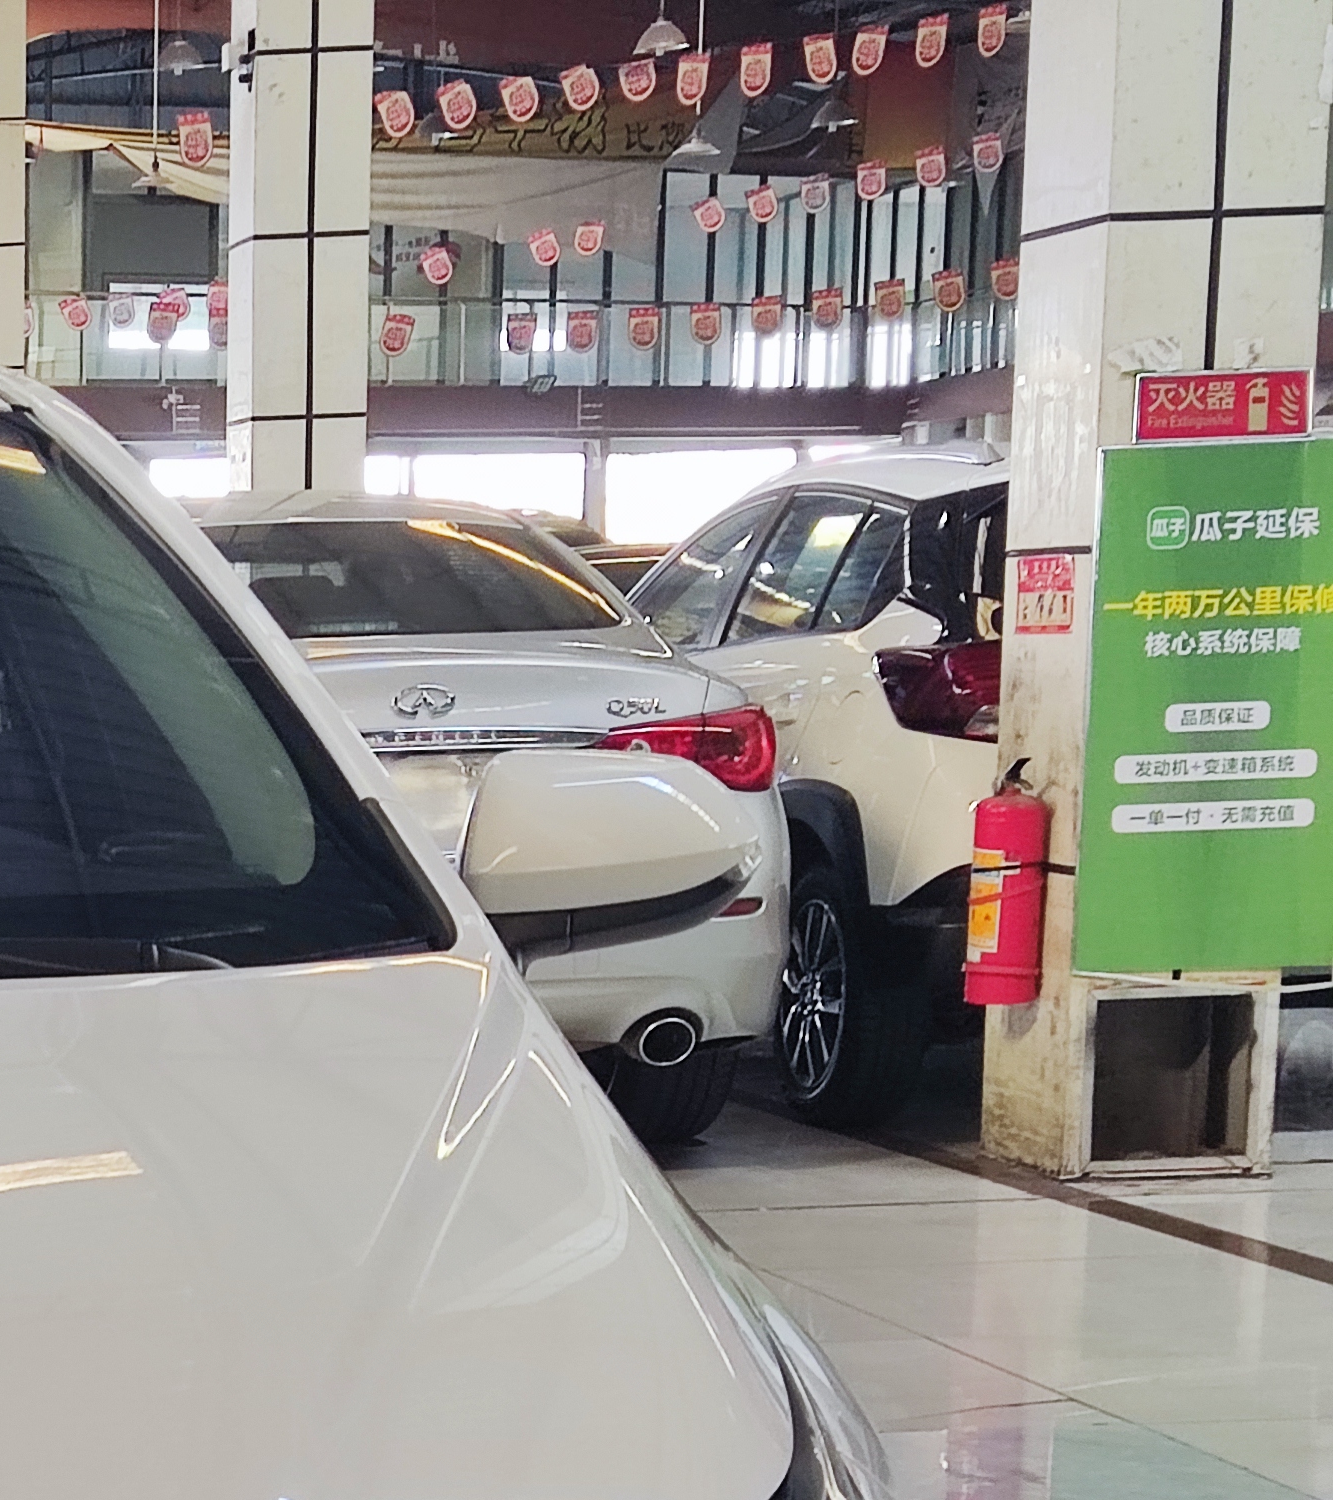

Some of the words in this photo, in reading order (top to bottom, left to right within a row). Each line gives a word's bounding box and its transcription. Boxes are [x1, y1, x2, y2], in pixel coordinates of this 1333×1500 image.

[1148, 381, 1236, 412] 灭火器
[1150, 517, 1185, 538] 瓜子
[1191, 506, 1321, 541] 瓜子延保
[1103, 583, 1333, 620] 一年两万公里保修
[1144, 626, 1301, 658] 核心系统保障
[605, 697, 666, 718] Q50L
[1180, 707, 1255, 726] 品质保证
[1135, 755, 1296, 777] 发动机+变速箱系统
